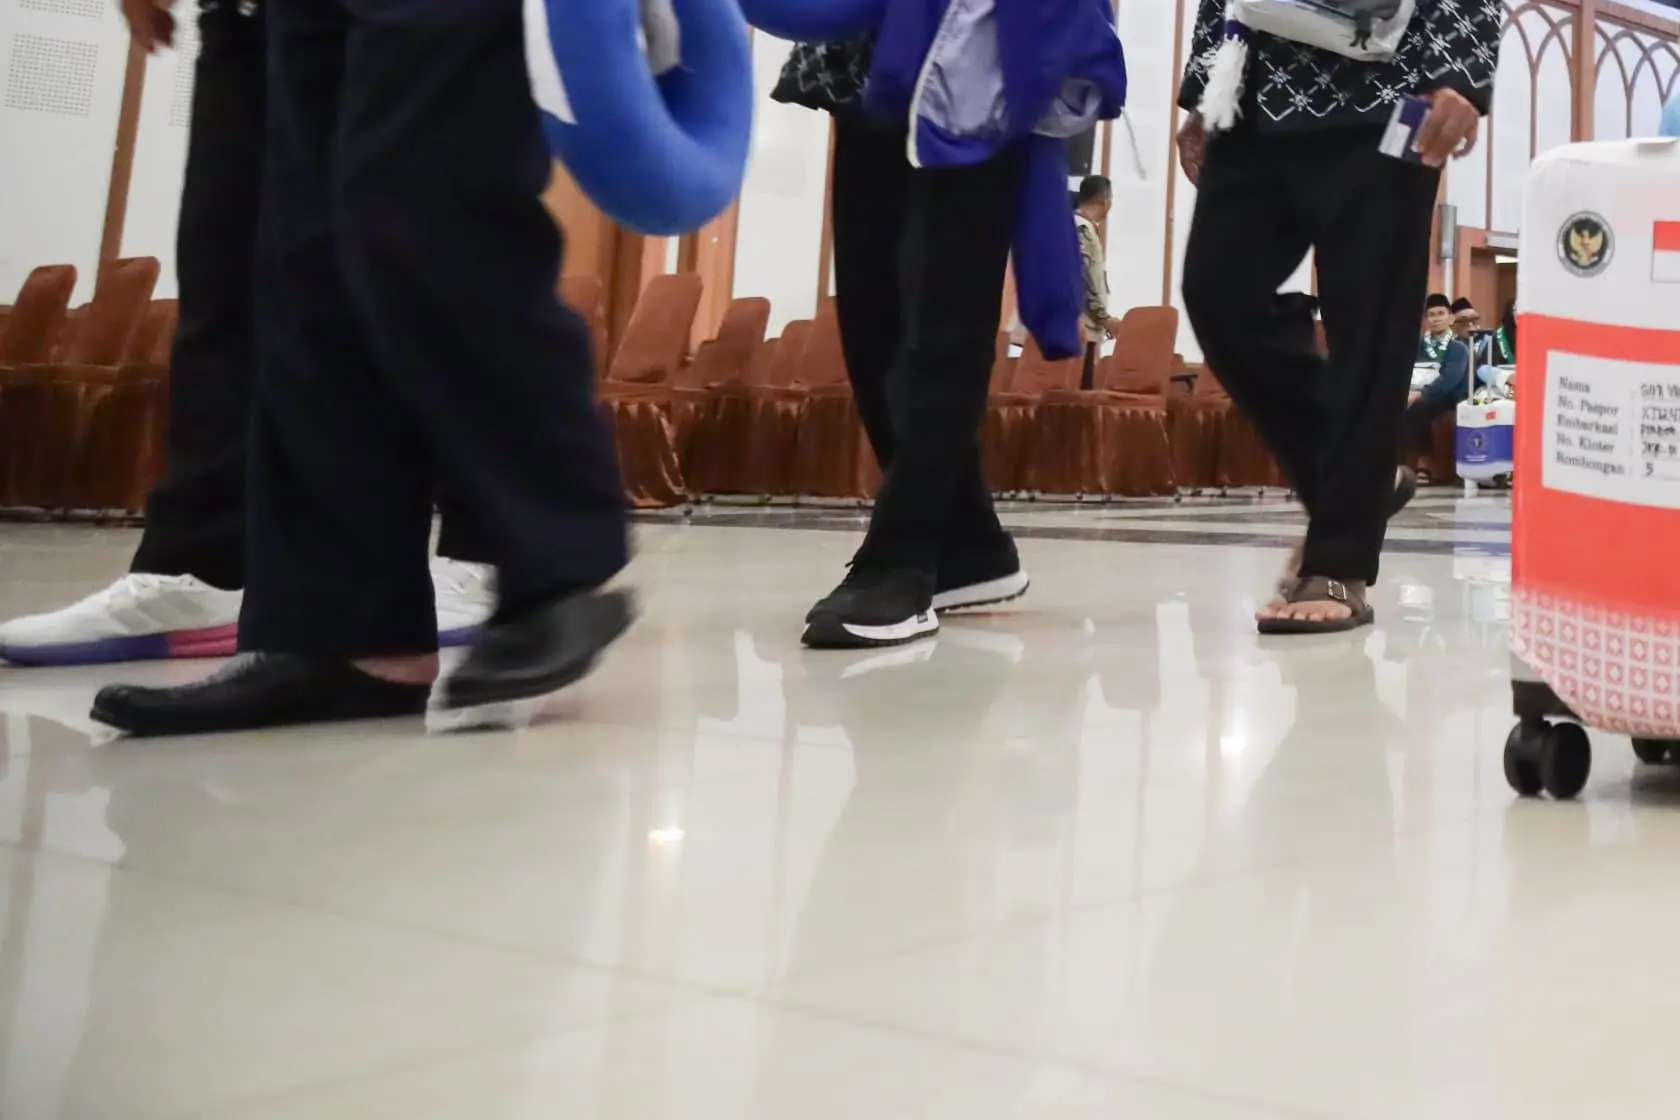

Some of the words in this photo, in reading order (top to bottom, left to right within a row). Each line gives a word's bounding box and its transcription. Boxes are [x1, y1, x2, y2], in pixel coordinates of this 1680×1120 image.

[1559, 376, 1591, 393] Nama
[1580, 400, 1618, 417] Paspor
[1556, 414, 1618, 436] Embarkasi
[1578, 437, 1614, 454] Kloter
[1556, 452, 1625, 477] Rombongan
